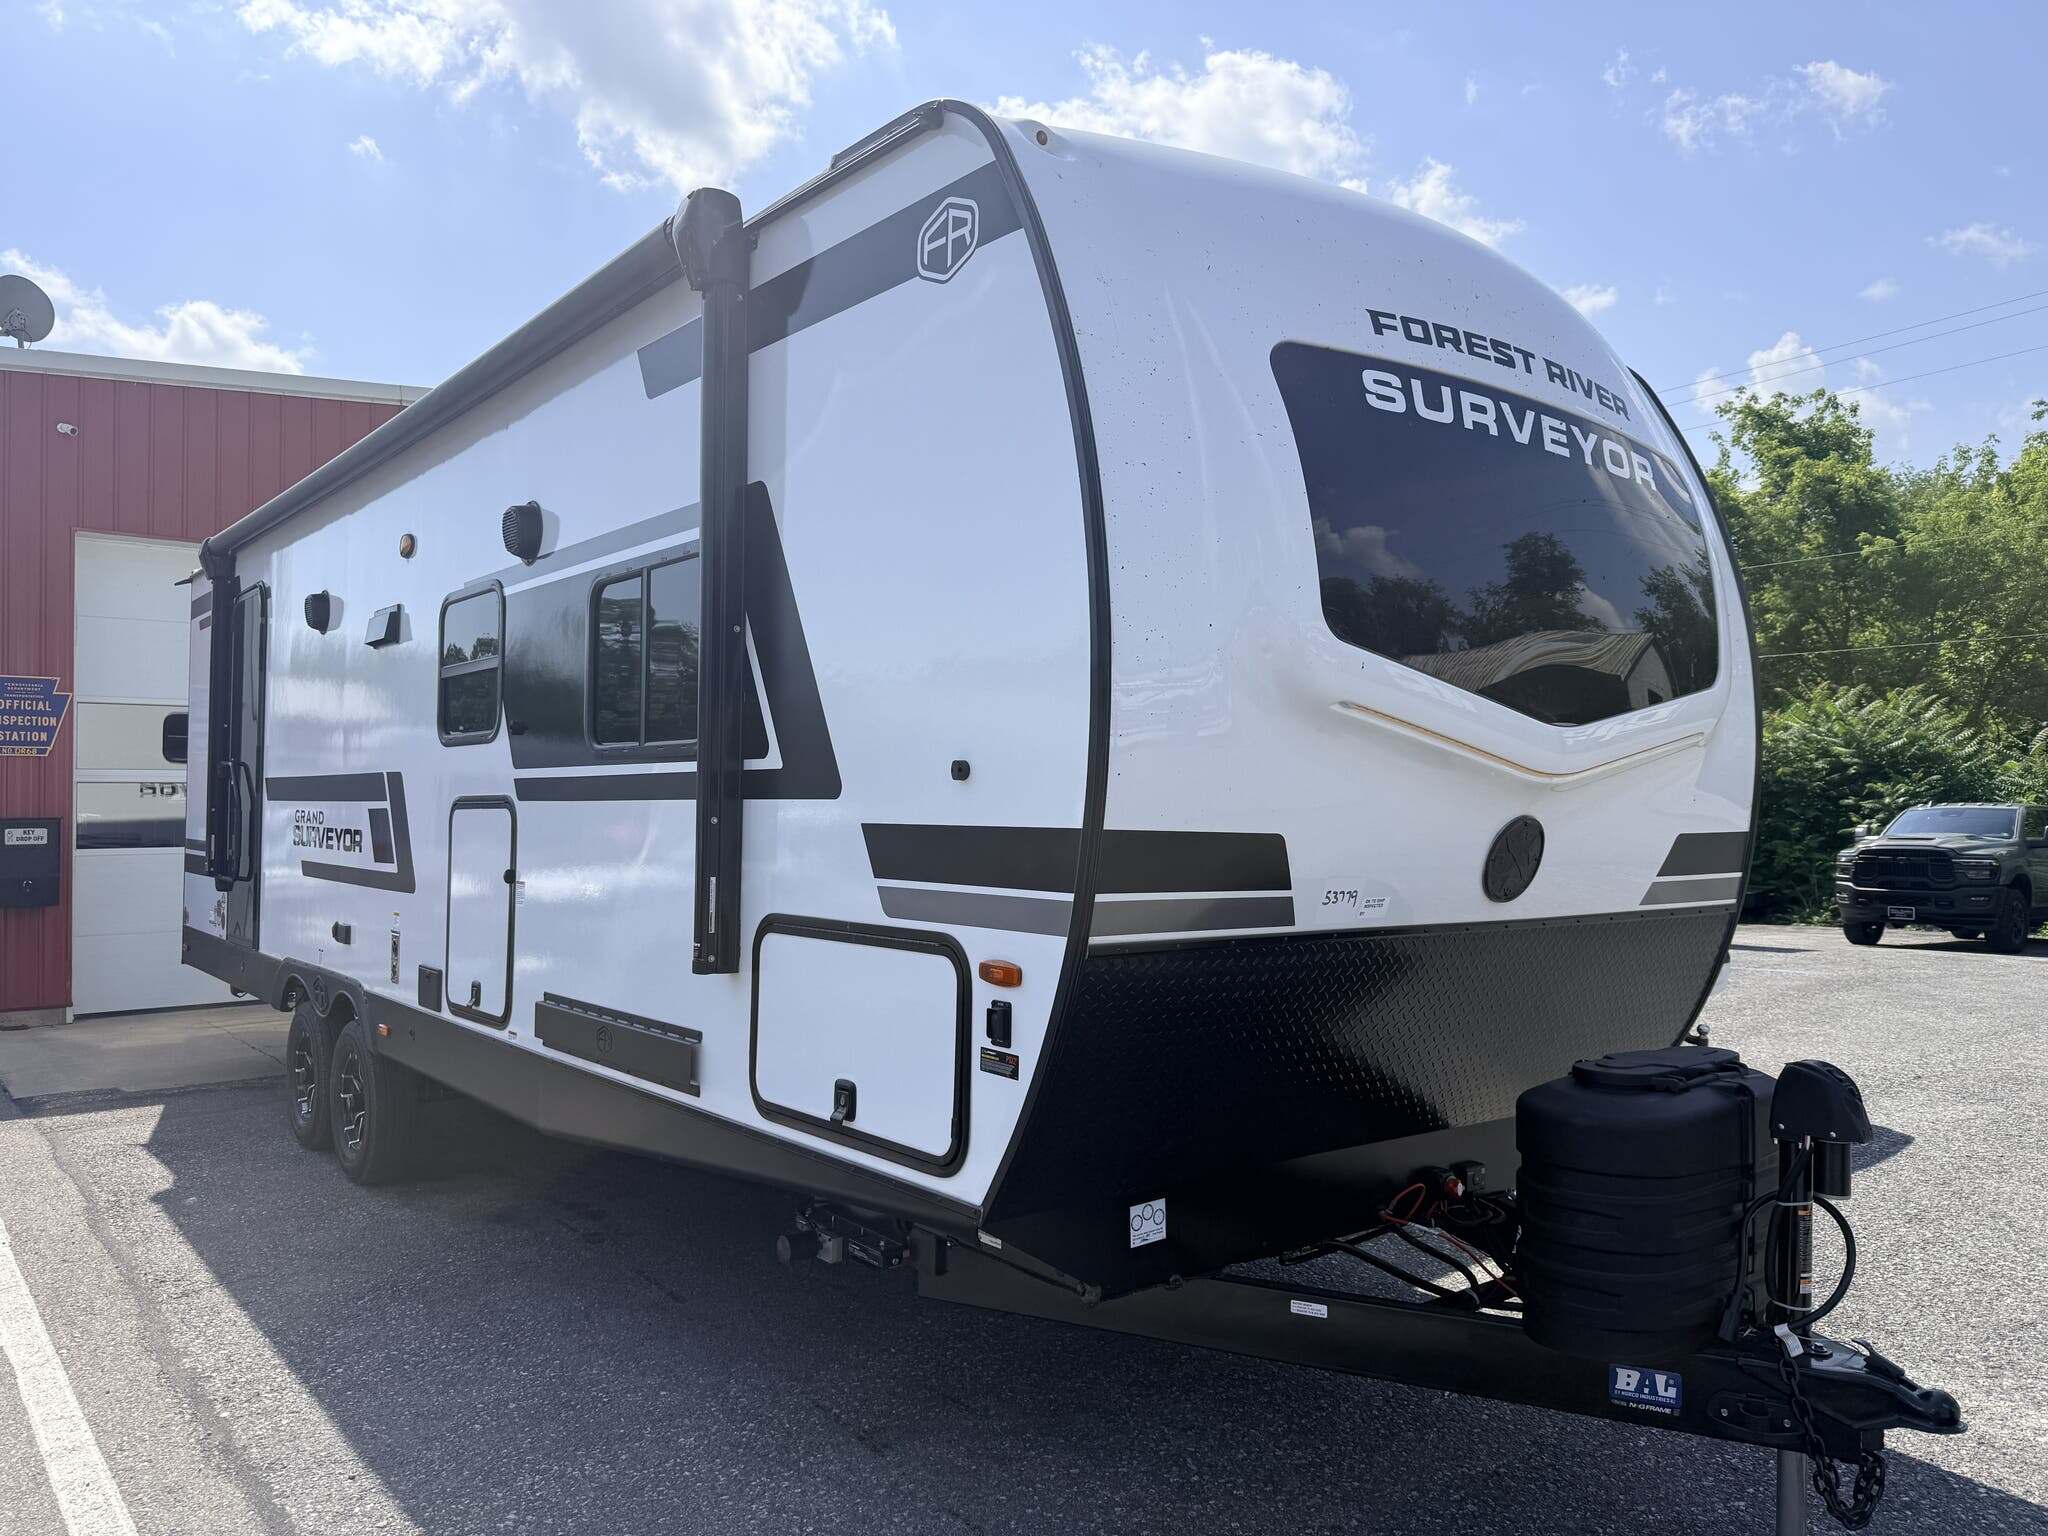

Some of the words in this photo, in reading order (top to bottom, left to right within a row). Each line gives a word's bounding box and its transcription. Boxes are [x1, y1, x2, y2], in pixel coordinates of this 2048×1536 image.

[1365, 308, 1536, 375] FOREST
[1542, 357, 1631, 422] RIVER
[1361, 368, 1658, 491] SURVEYOR
[0, 700, 52, 711] OFFICIAL
[0, 715, 57, 726] SPECTION
[0, 731, 48, 742] STATION
[294, 809, 325, 825] GRAND
[292, 824, 363, 853] SURVEYOR
[1322, 889, 1359, 908] 53779
